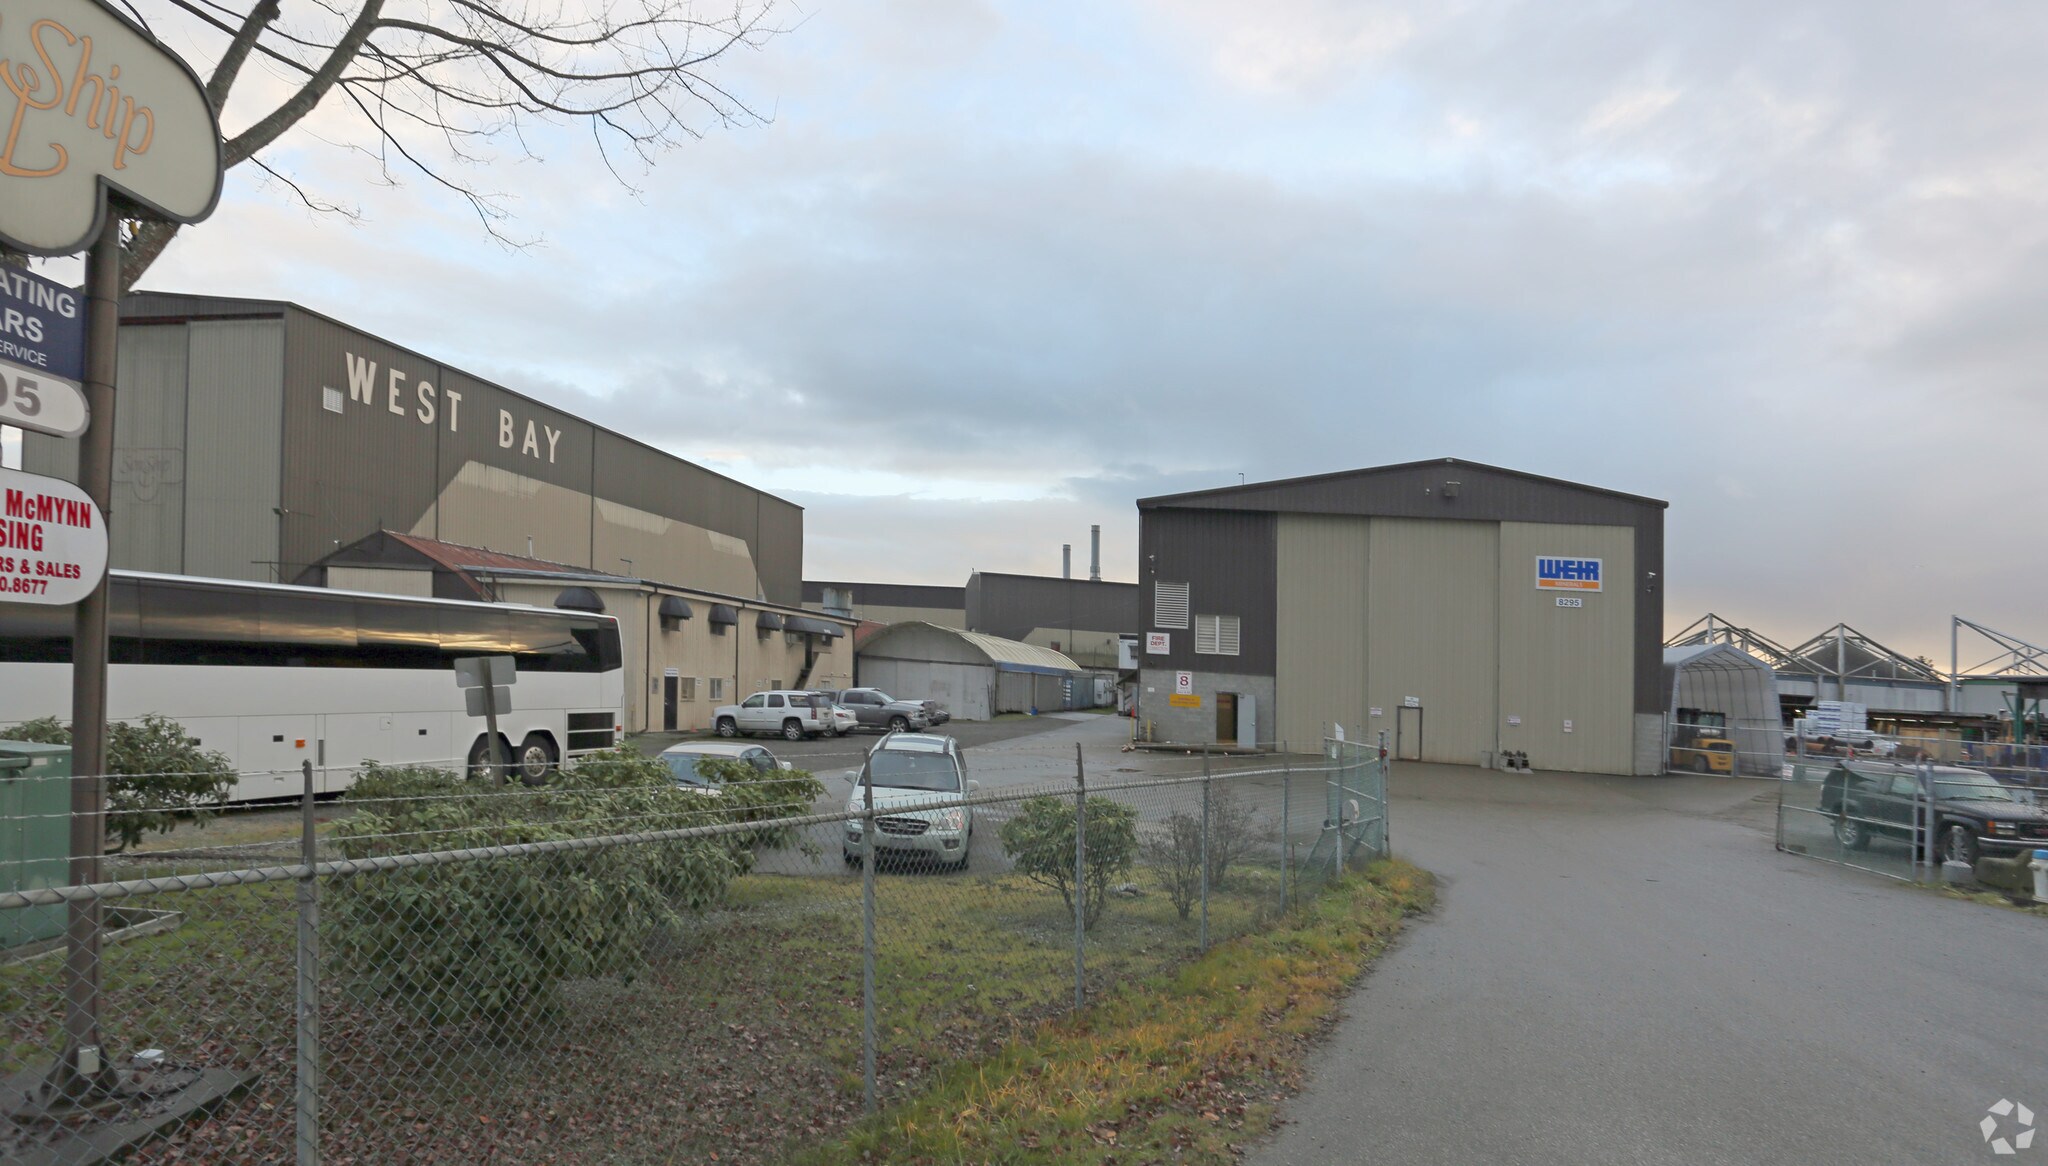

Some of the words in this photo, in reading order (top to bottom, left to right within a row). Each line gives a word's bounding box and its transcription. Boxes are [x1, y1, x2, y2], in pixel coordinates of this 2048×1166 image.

[0, 19, 155, 170] Ship
[0, 307, 44, 343] RS
[345, 351, 462, 432] WEST
[498, 408, 561, 463] BAY
[6, 488, 91, 529] McMYNN
[20, 558, 30, 574] &
[36, 560, 81, 579] SALES
[1538, 559, 1599, 581] WEIR
[1558, 598, 1580, 607] 8295
[1180, 675, 1189, 686] 8
